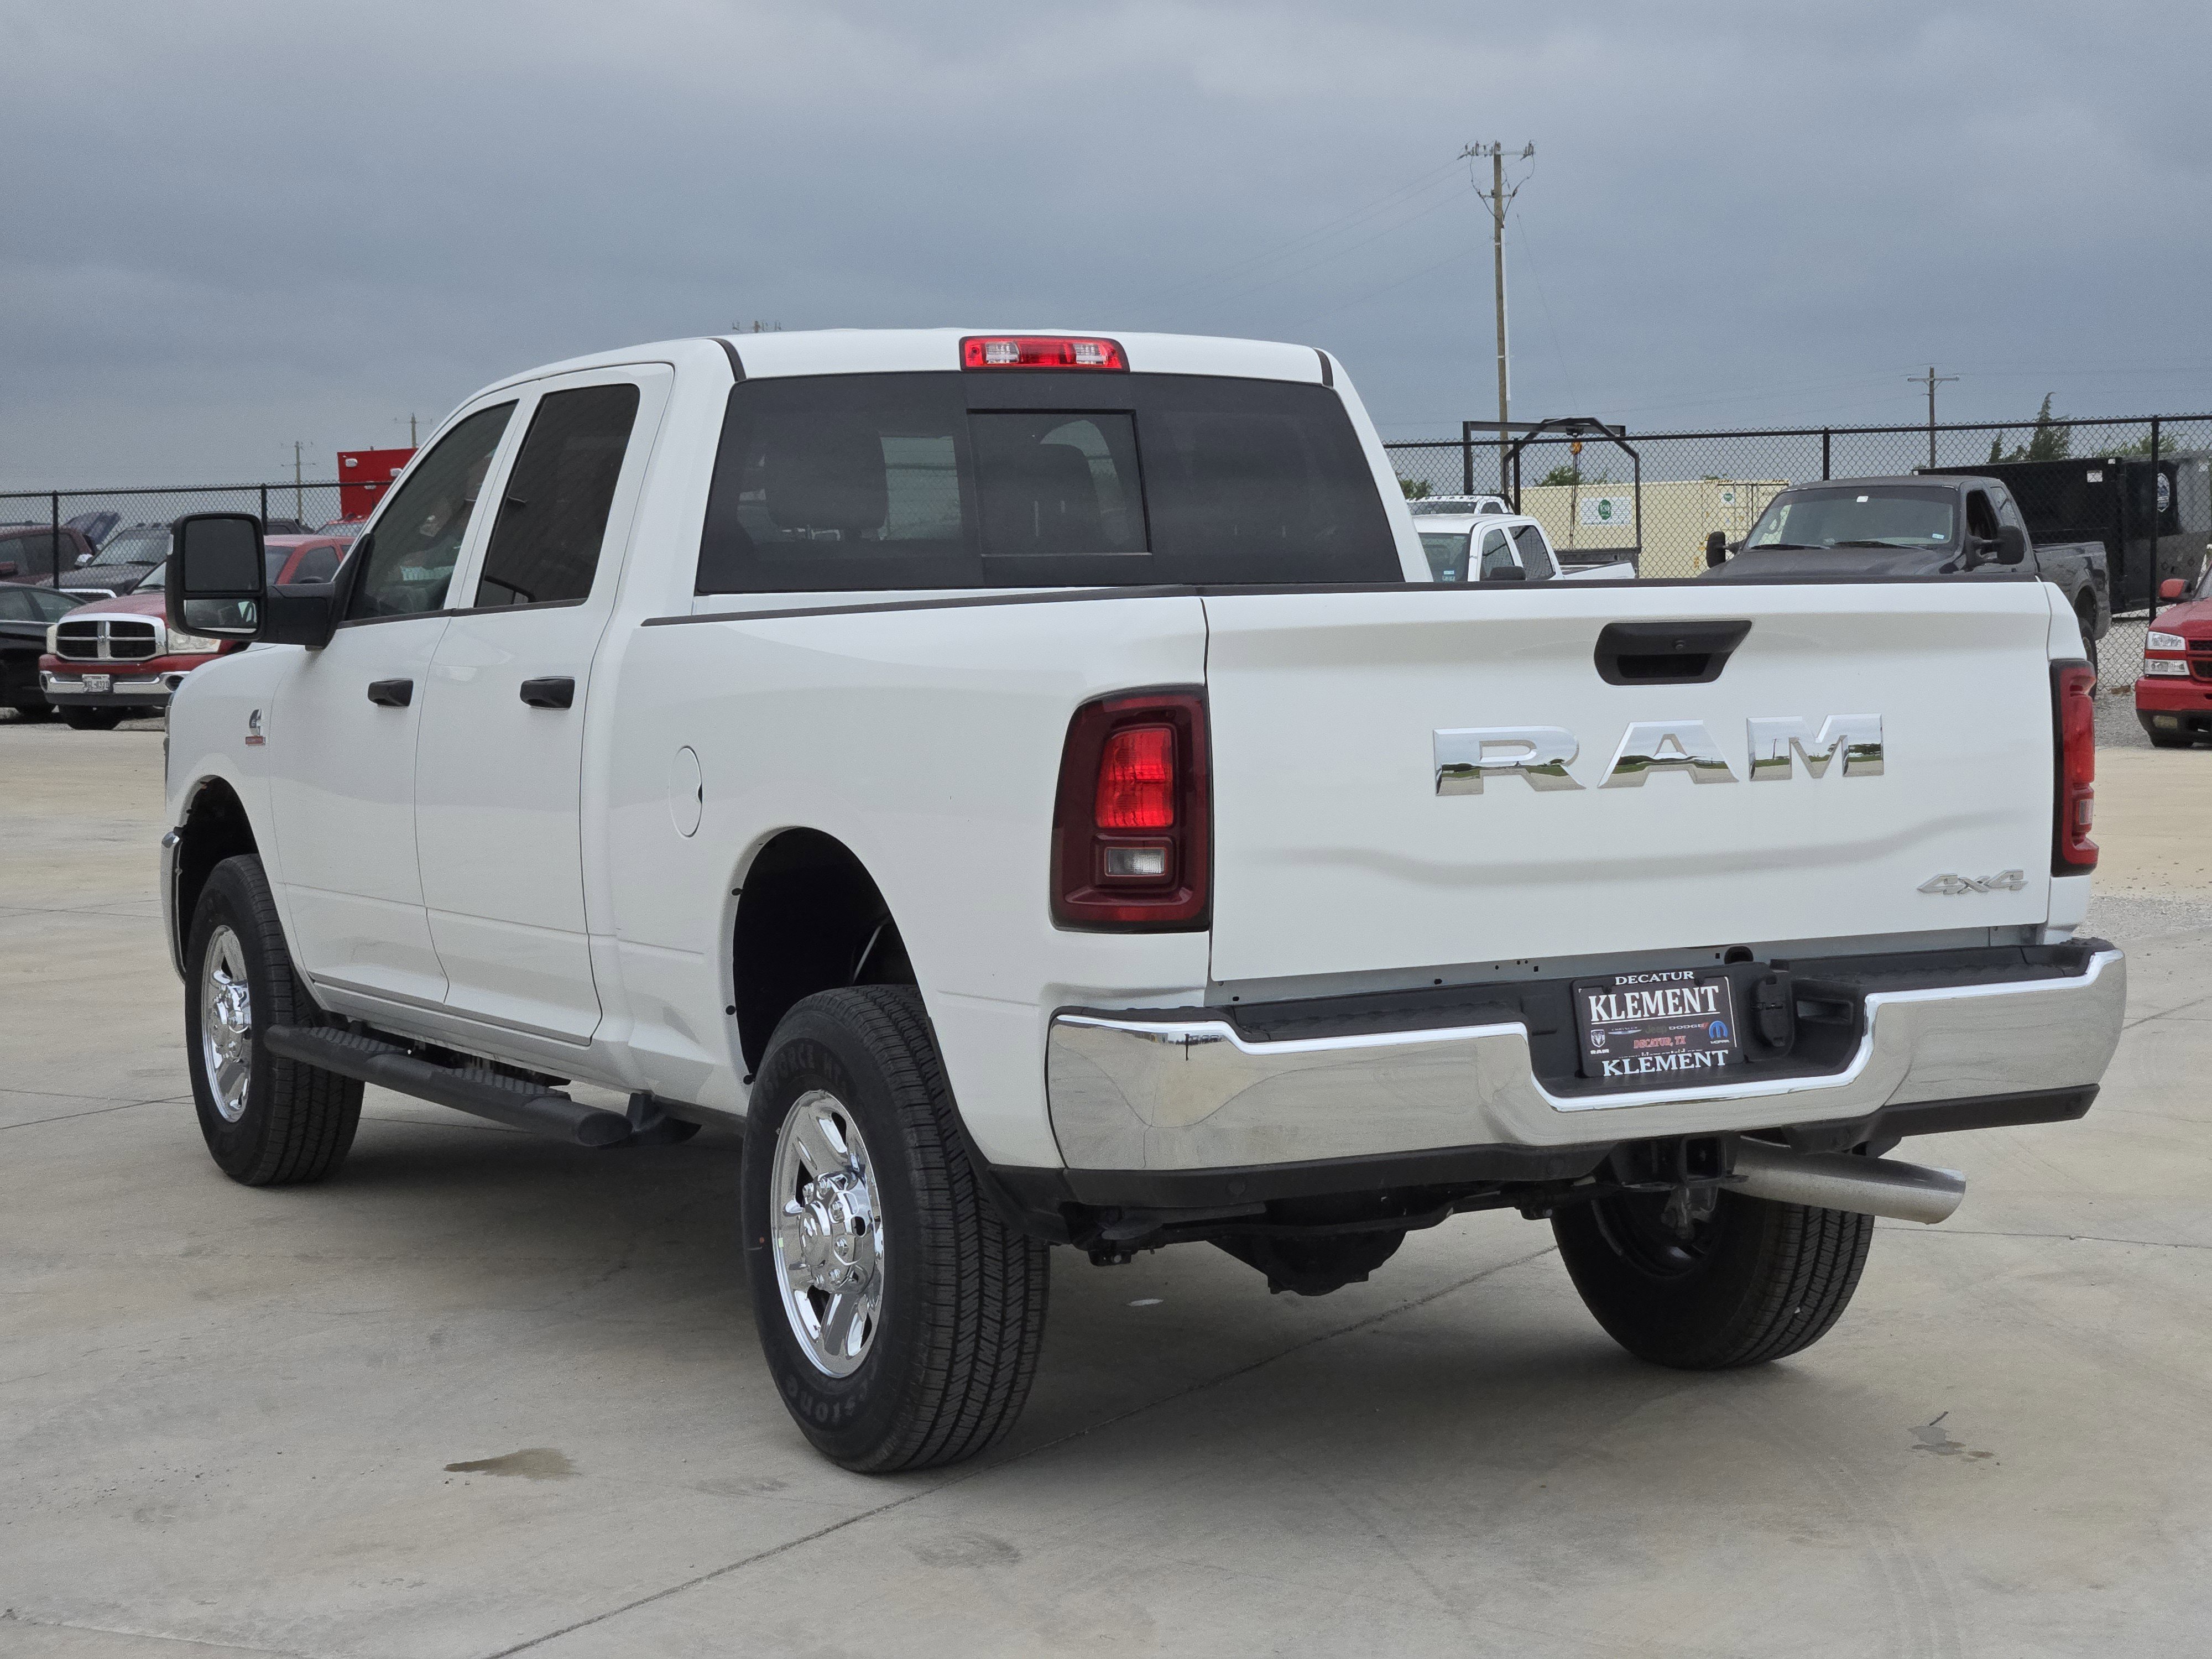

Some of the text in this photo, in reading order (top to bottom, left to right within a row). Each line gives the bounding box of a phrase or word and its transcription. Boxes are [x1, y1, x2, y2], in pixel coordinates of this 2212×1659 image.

[1433, 713, 1885, 796] RAM
[1917, 869, 2030, 895] 4x4
[1615, 971, 1694, 985] DECATUR
[1589, 985, 1719, 1022] KLEMENT
[1633, 1035, 1686, 1049] DECATUR, TX
[1601, 1049, 1729, 1077] KLEMENT
